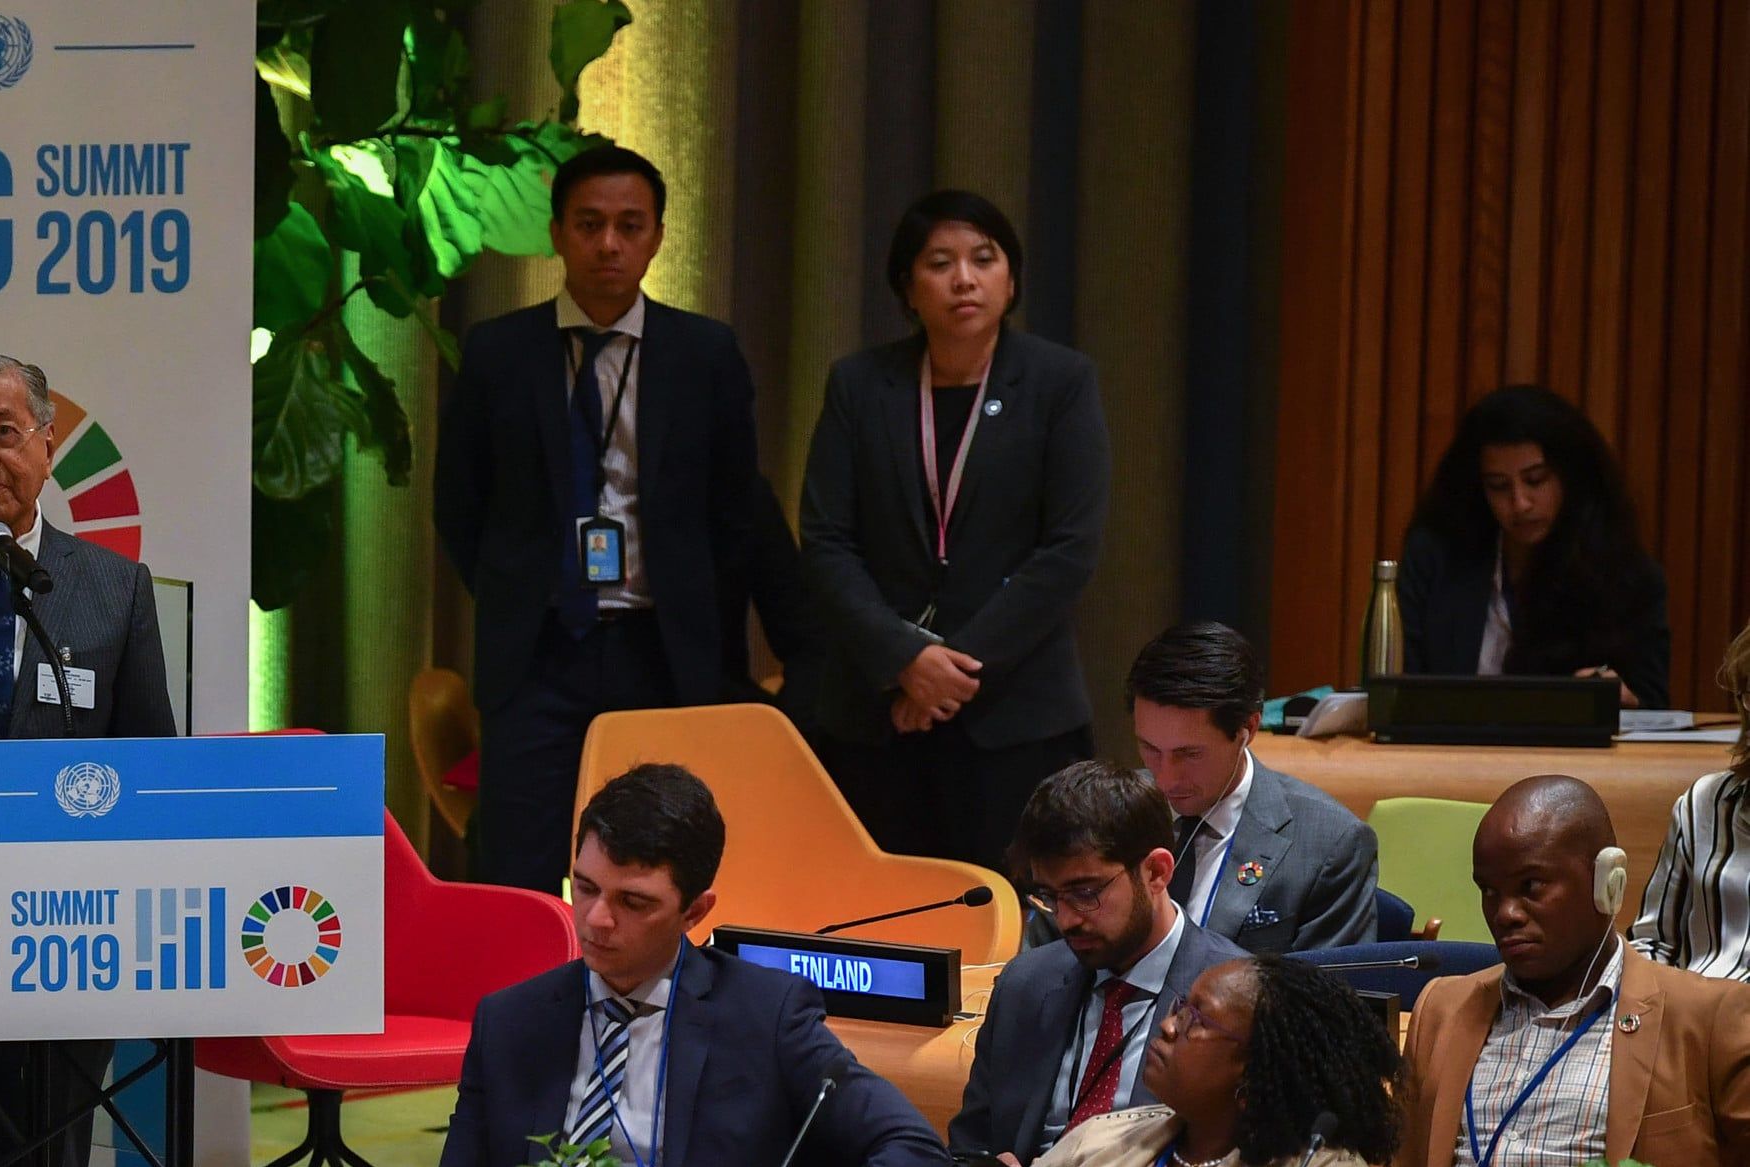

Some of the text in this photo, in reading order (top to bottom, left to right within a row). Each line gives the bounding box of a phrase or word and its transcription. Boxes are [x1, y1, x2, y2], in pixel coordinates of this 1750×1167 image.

[36, 143, 190, 197] SUMMIT
[37, 209, 190, 295] 2019
[11, 890, 119, 926] SUMMIT
[12, 934, 120, 992] 2019
[790, 954, 872, 992] FINLAND
